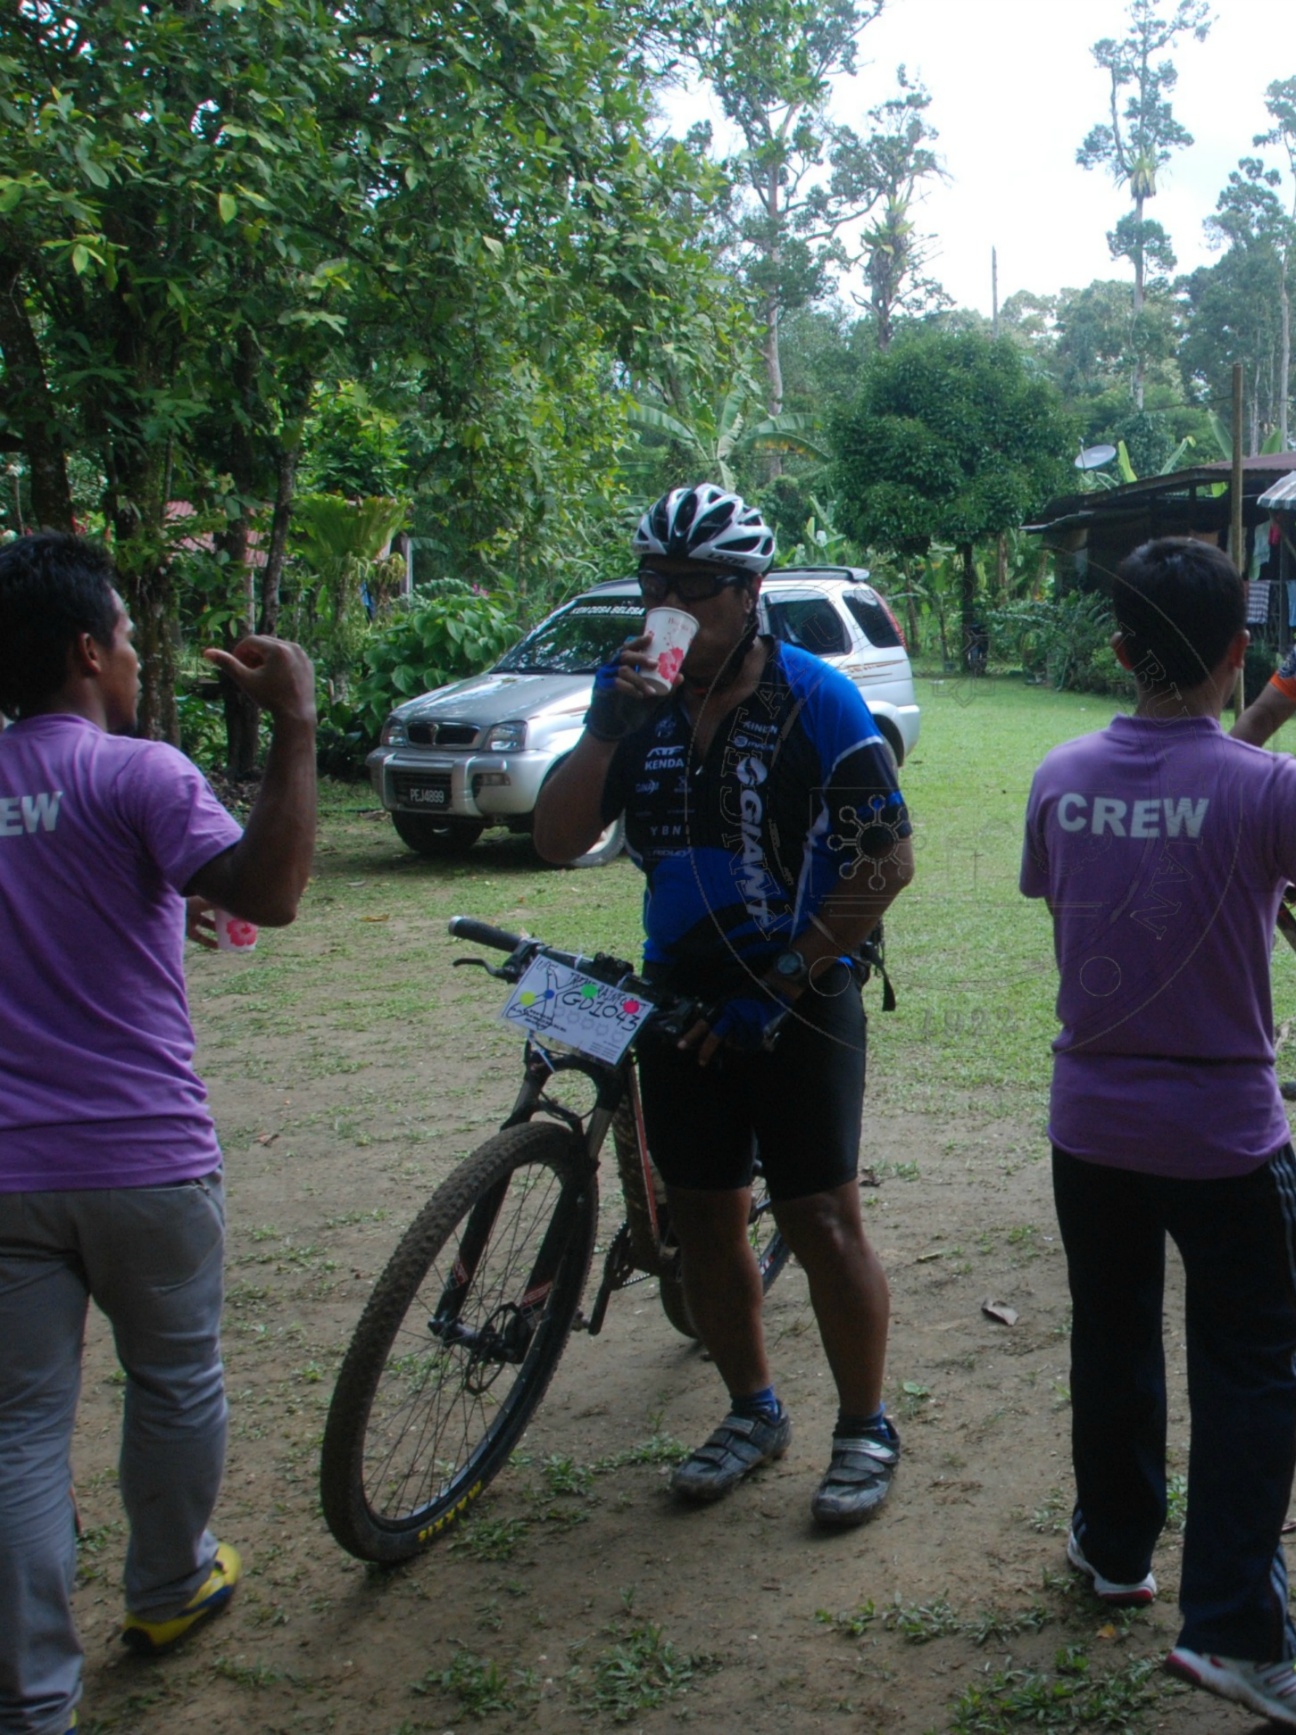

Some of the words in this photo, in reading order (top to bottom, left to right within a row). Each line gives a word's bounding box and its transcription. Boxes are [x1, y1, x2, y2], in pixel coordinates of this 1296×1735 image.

[644, 758, 685, 771] KENDA
[409, 788, 445, 803] PEJ4899
[1057, 792, 1209, 838] CREW
[740, 789, 770, 929] GIANT
[562, 991, 641, 1032] GD1043
